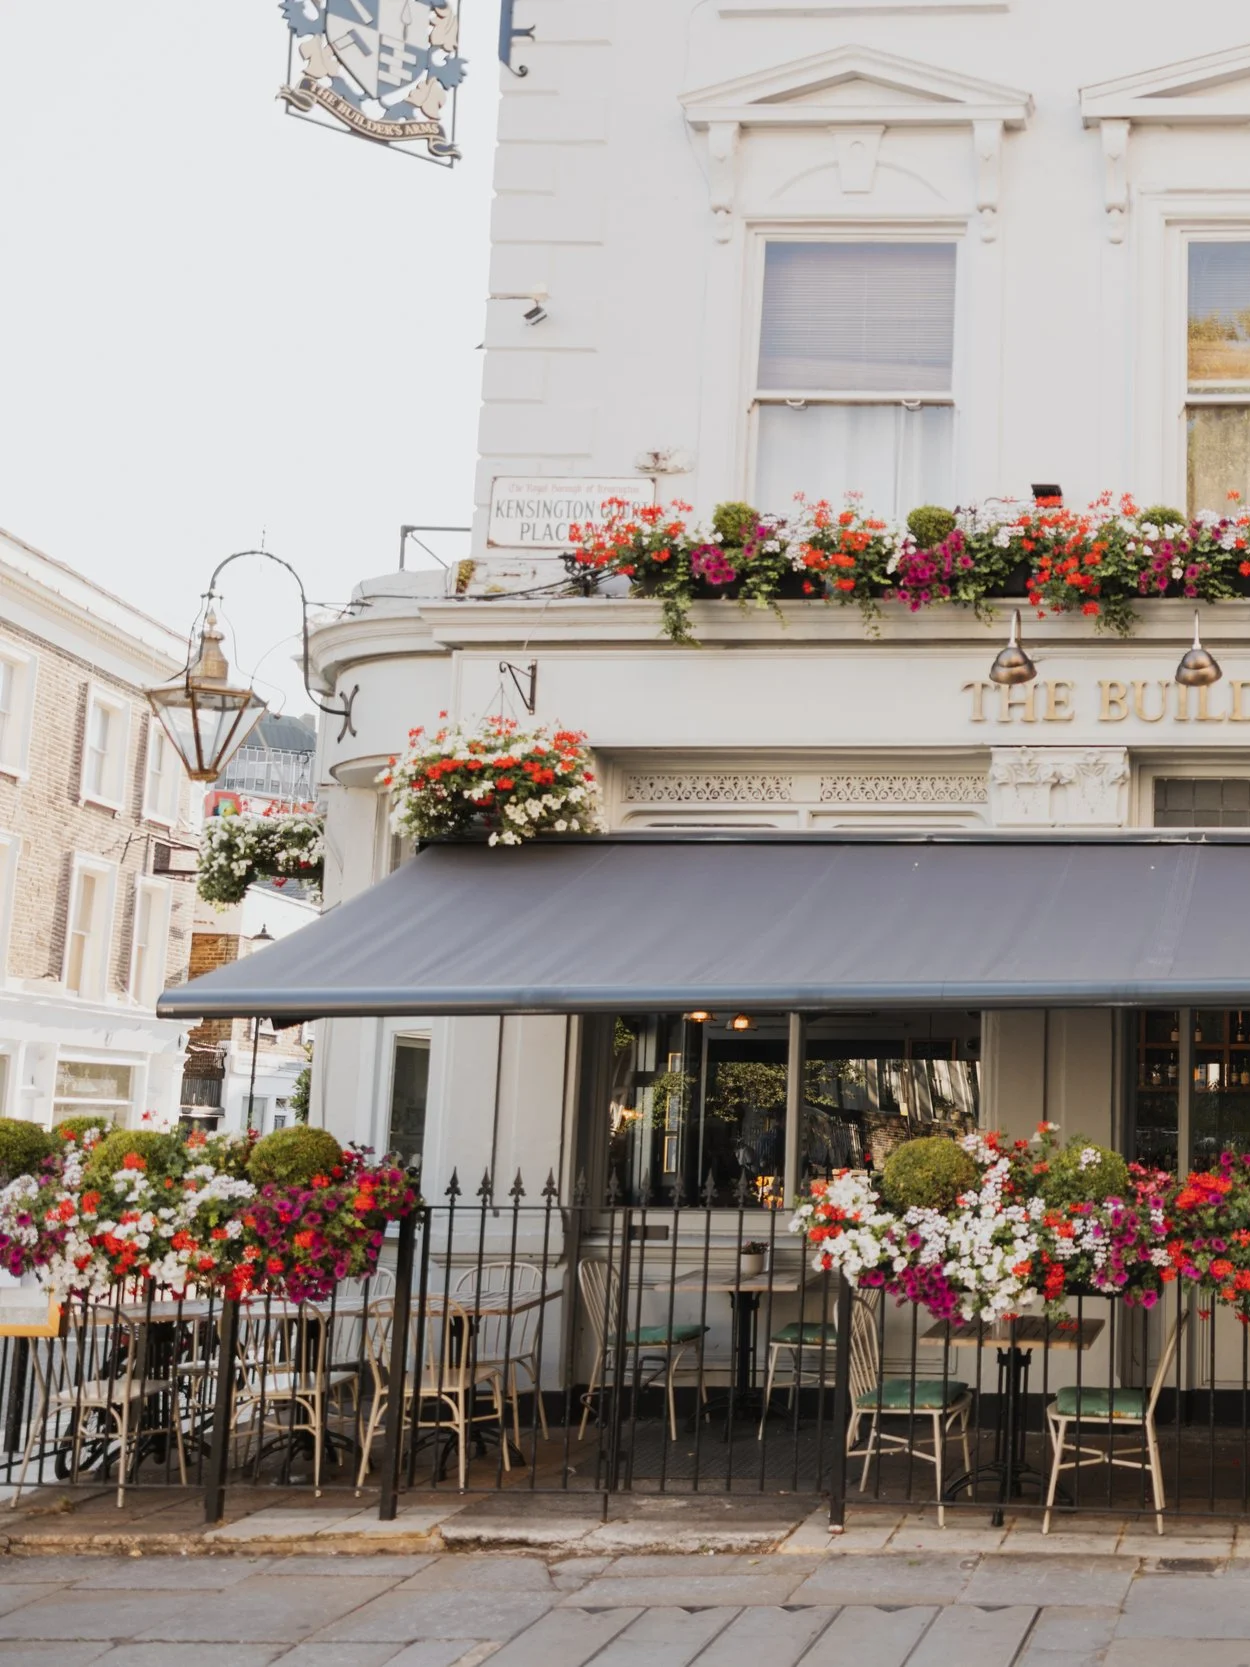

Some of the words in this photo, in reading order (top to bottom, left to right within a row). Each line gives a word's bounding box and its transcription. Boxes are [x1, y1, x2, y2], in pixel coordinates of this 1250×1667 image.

[309, 81, 338, 105] THE
[337, 103, 403, 137] BUILDER'S
[405, 122, 440, 136] ARMS
[495, 499, 595, 519] KENSINGTON
[520, 522, 573, 541] PLAC
[961, 679, 1075, 722] THE
